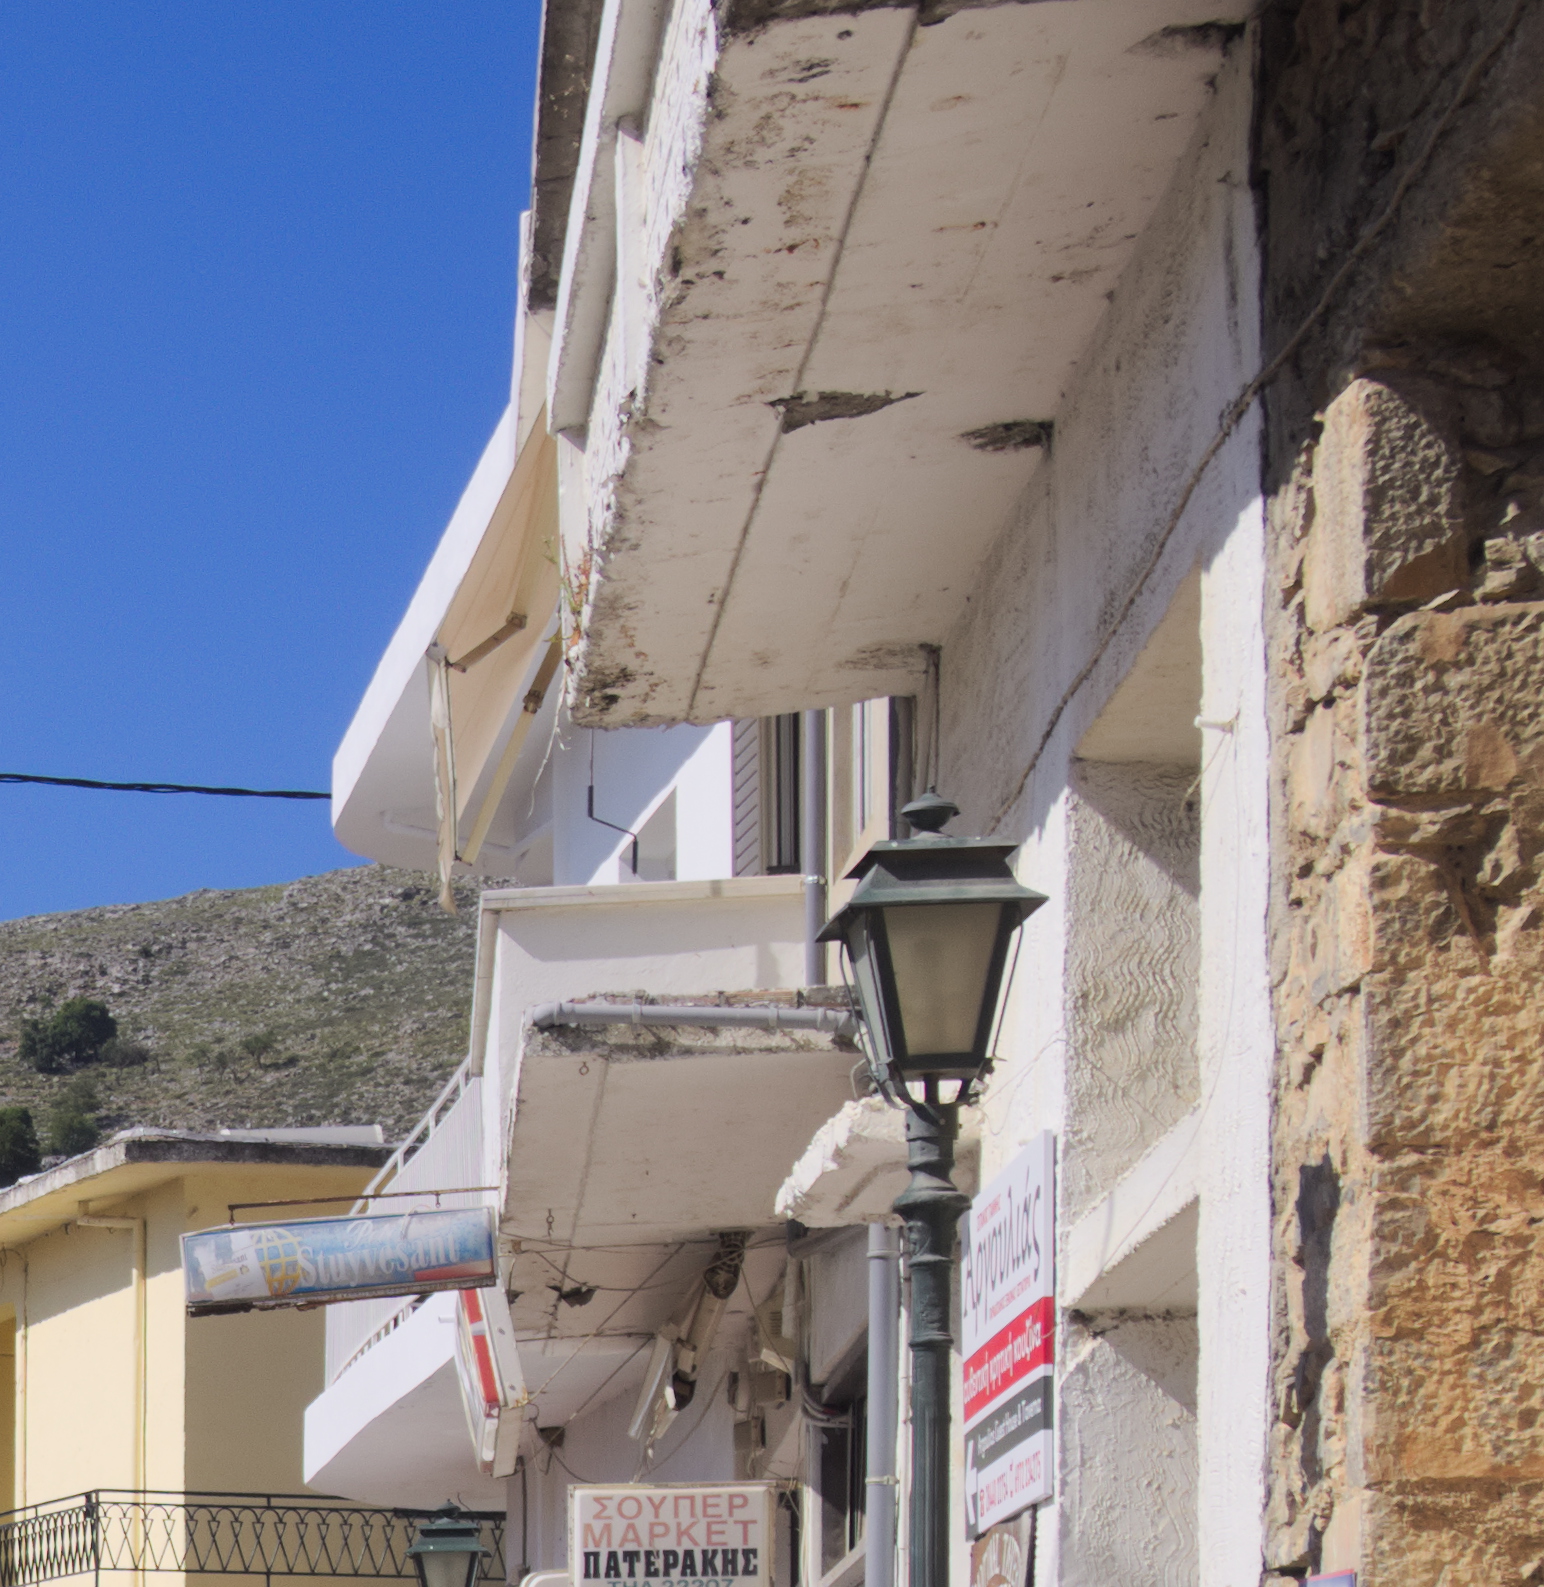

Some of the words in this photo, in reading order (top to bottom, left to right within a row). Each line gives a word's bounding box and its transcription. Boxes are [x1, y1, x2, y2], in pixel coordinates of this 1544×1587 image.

[297, 1232, 460, 1288] Stuyvesant
[592, 1493, 750, 1520] ΣΟΥΠΕΡ
[582, 1519, 758, 1549] ΜΑΡΚΕΤ
[583, 1547, 758, 1579] ΠΑΤΕΡΑΚΗΣ
